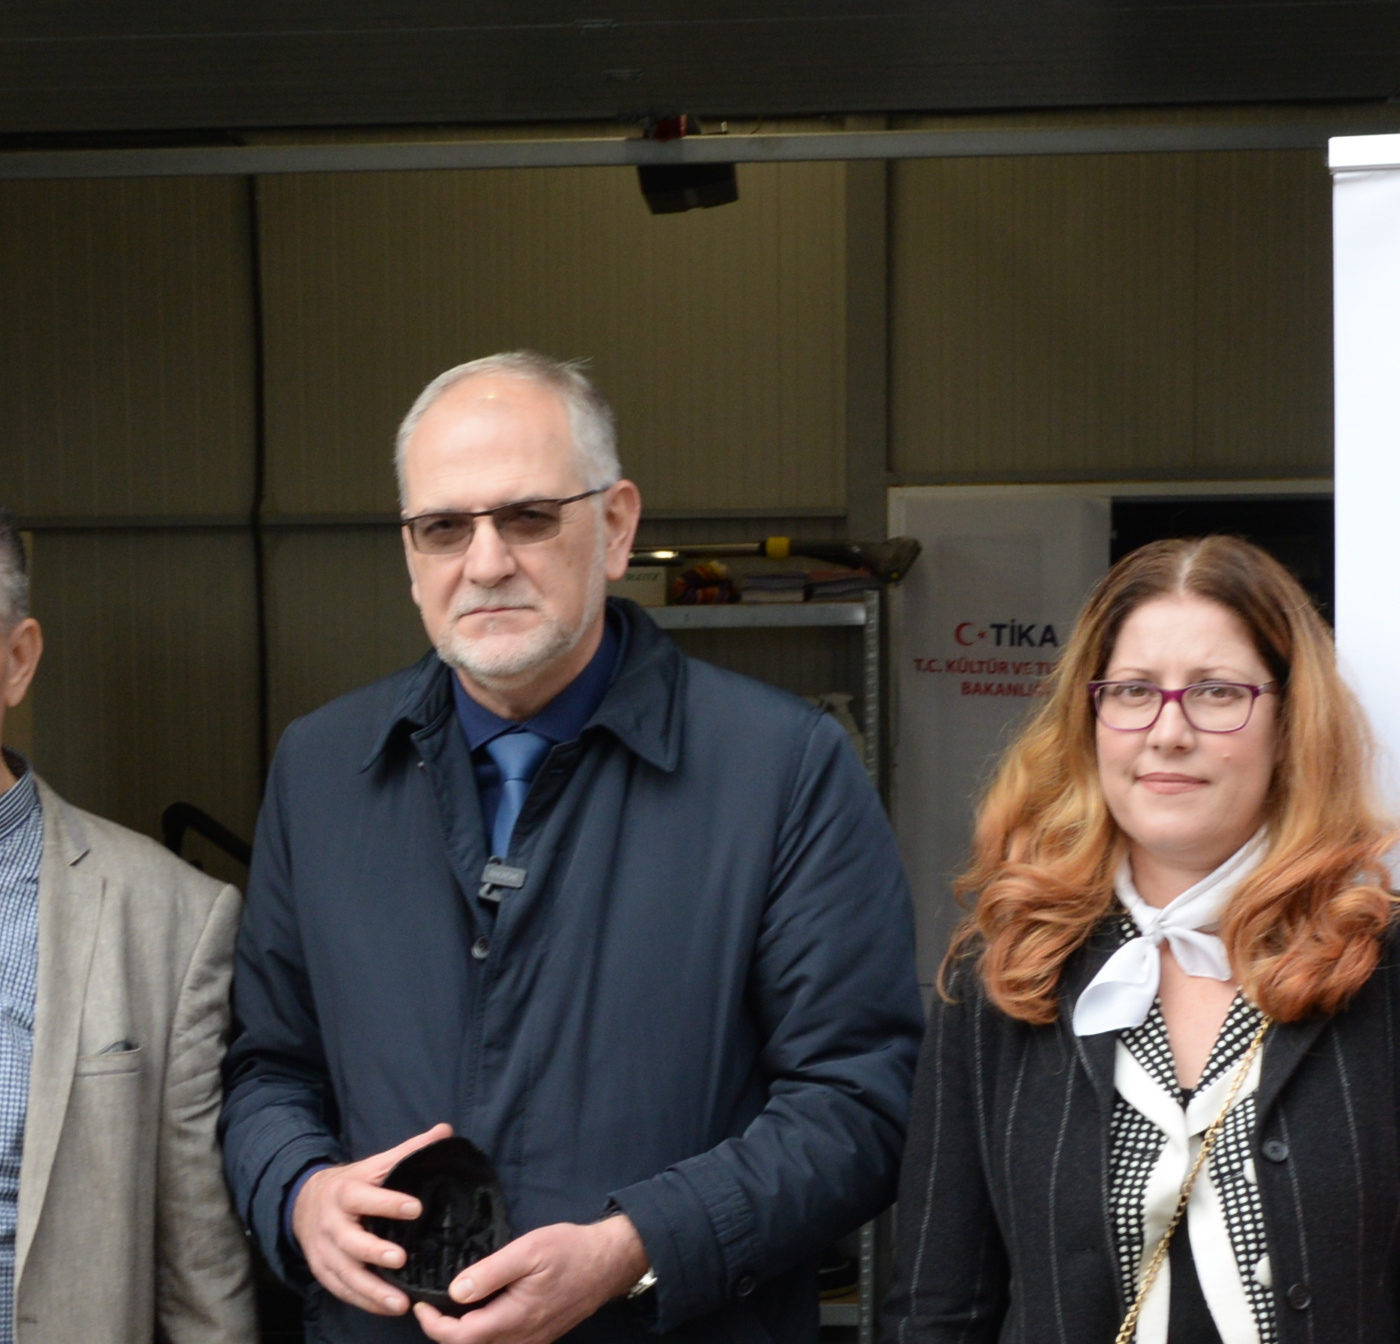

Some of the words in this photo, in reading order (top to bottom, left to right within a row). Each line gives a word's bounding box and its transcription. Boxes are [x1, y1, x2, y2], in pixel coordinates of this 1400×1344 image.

[989, 618, 1059, 647] TİKA
[914, 658, 942, 673] T.C.
[945, 657, 1009, 675] KÜLTÜR
[1012, 661, 1033, 675] VE
[1036, 661, 1060, 676] TU
